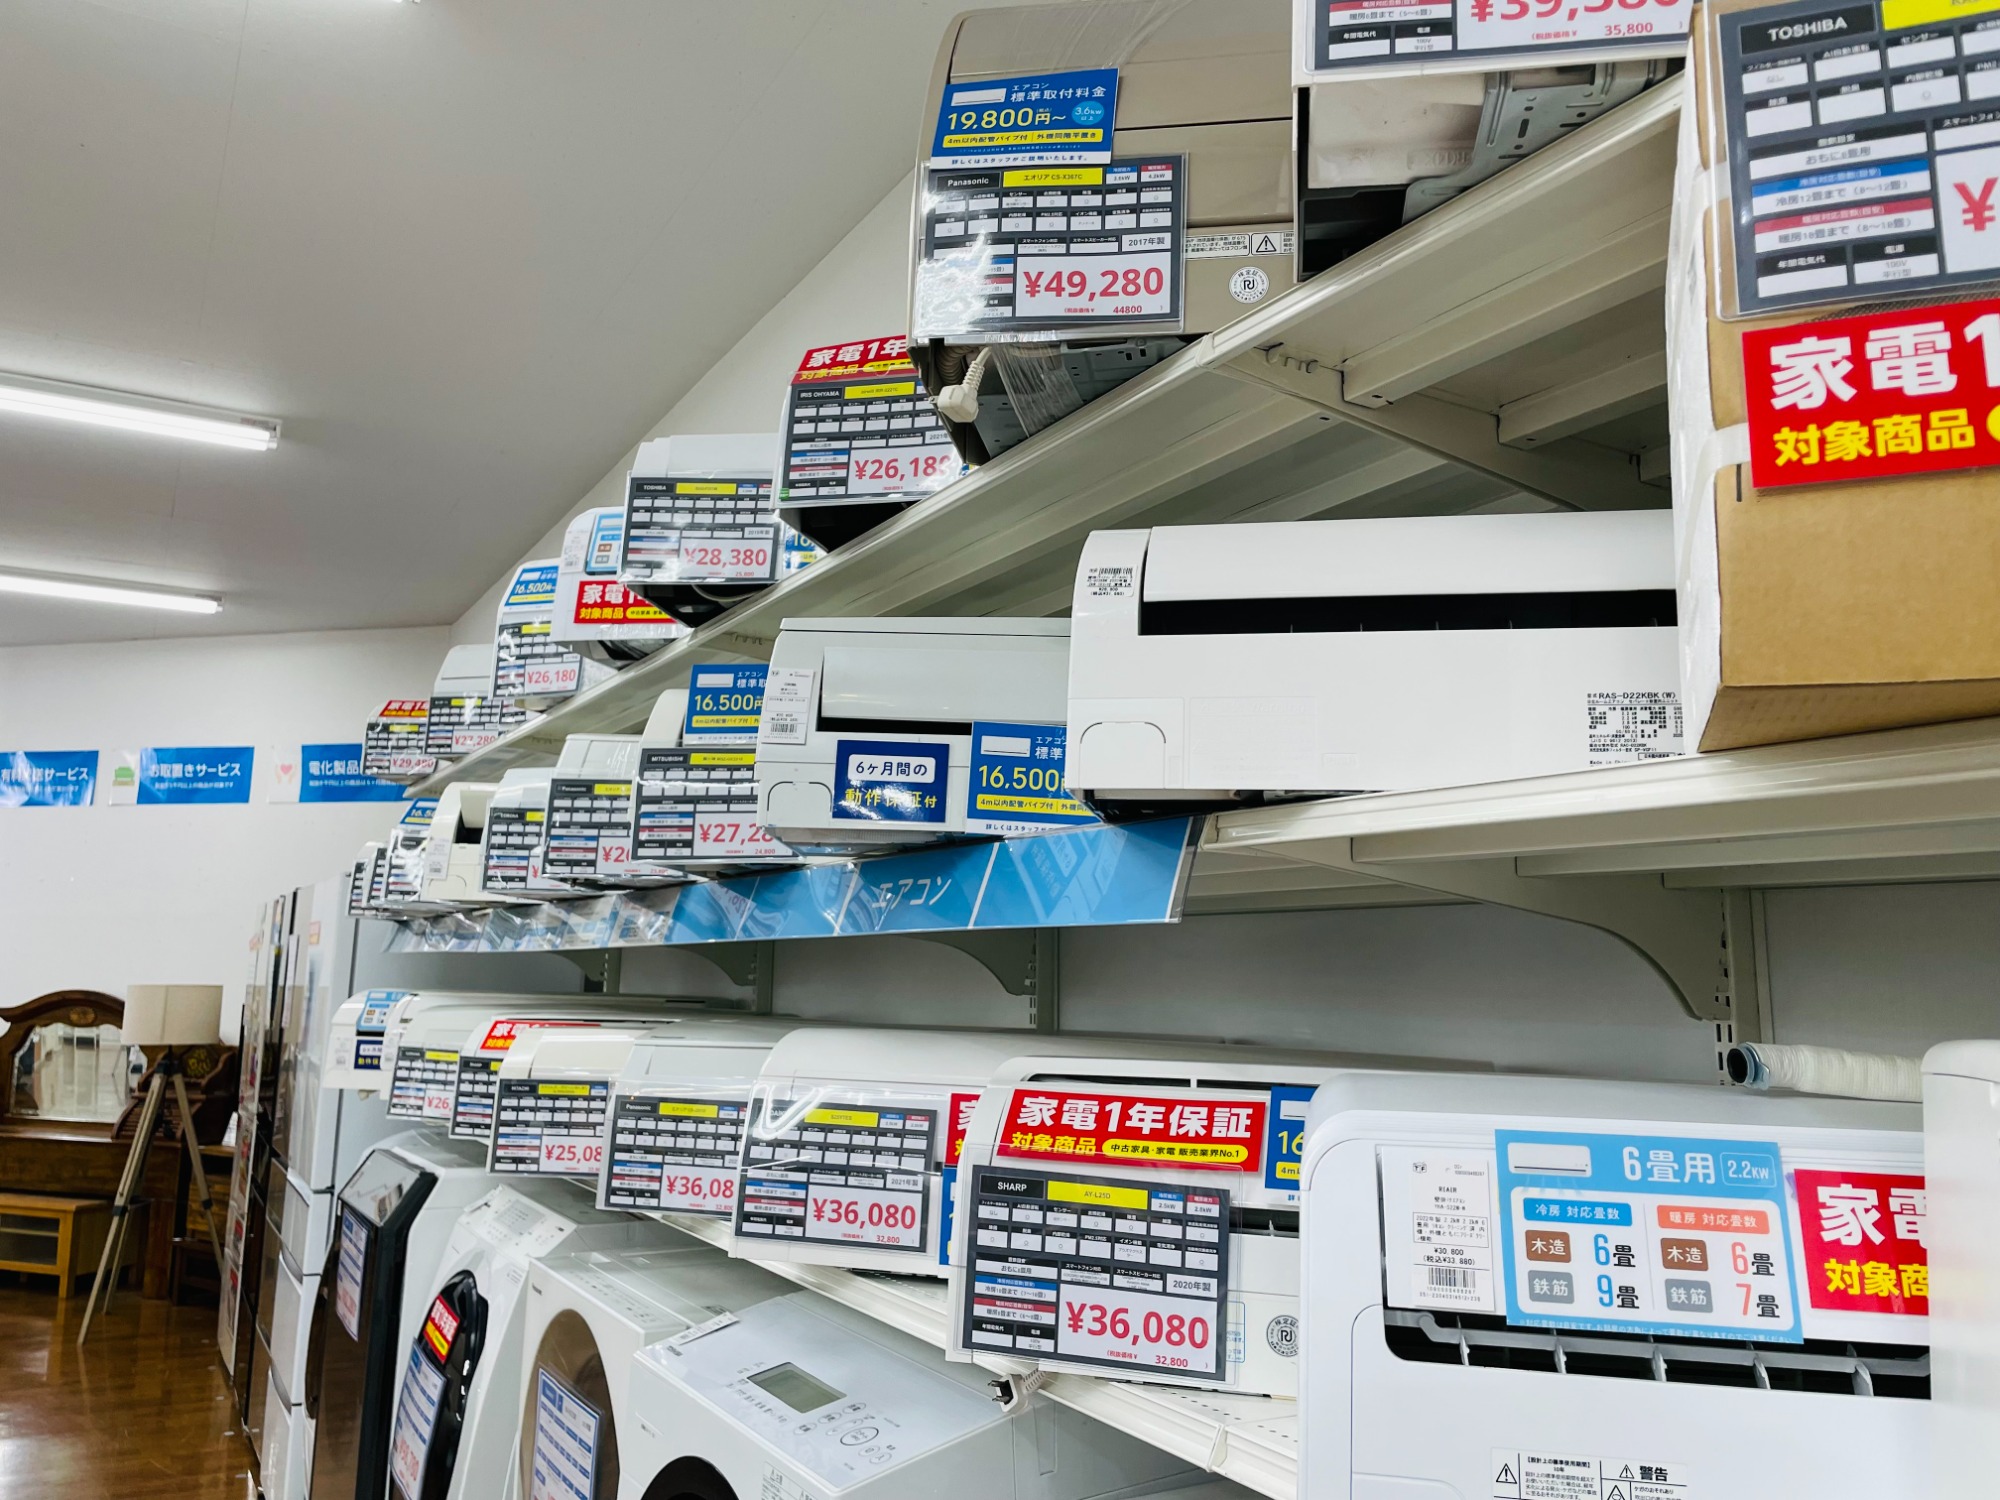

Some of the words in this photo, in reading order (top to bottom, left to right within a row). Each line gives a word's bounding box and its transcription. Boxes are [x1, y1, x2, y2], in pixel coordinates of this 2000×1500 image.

[1604, 22, 1653, 36] 35,800
[1768, 16, 1848, 41] TOSHIBA
[1010, 86, 1107, 103] 標準取付料金
[1011, 83, 1050, 91] エアコン
[948, 134, 1028, 145] 4m以内配管パイプ付
[952, 155, 1088, 165] 詳しくはスタッフがご説明いたします。
[947, 177, 989, 187] Panasonic
[1128, 237, 1165, 246] 2017年製
[1023, 267, 1164, 302] ¥49,280
[1112, 305, 1143, 314] 44800
[807, 339, 907, 368] 家電1年
[813, 390, 839, 398] OHYAMA
[1773, 408, 1976, 467] 対象商品
[684, 548, 768, 569] ¥28,380
[581, 583, 650, 605] 家電1
[579, 606, 624, 620] 対象商品
[527, 668, 577, 685] ¥26,180
[1034, 746, 1064, 760] 標準
[150, 762, 241, 779] お取置きサービス
[309, 760, 360, 776] 電化製品
[855, 761, 928, 777] 6ヶ月間の
[978, 765, 1065, 792] 16,500
[980, 798, 1054, 810] 4m以内配管パイプ付
[872, 878, 952, 909] エアコン
[626, 1103, 652, 1111] Panasonic
[1016, 1096, 1254, 1139] 家電1年保証
[1011, 1131, 1097, 1156] 対象商品
[1110, 1143, 1176, 1157] 中古家具・家電
[1178, 1147, 1240, 1159] 販売業界No.1
[1621, 1146, 1717, 1186] 6畳用
[666, 1175, 735, 1200] ¥36,08
[997, 1181, 1028, 1192] SHARP
[1084, 1190, 1111, 1199] AY-L25D
[812, 1197, 916, 1229] ¥36,080
[1535, 1204, 1561, 1217] 冷房
[1566, 1206, 1620, 1221] 対応畳数
[1669, 1211, 1699, 1225] 暖房
[1702, 1213, 1758, 1229] 対応畳数
[1817, 1183, 1927, 1250] 家電
[876, 1235, 900, 1244] 32,800
[1530, 1236, 1567, 1256] 木造
[1593, 1233, 1636, 1268] 6畳
[1666, 1245, 1703, 1263] 木造
[1730, 1241, 1776, 1277] 6畳
[1065, 1263, 1102, 1272] スマートフォン対応
[1116, 1269, 1161, 1279] スマートスピーカー対応
[1173, 1280, 1211, 1292] 2020年製
[1533, 1276, 1569, 1297] 鉄筋
[1597, 1274, 1640, 1310] 9畳
[1670, 1287, 1708, 1306] 鉄筋
[1735, 1283, 1781, 1319] 7畳
[1065, 1300, 1210, 1350] ¥36,080
[1154, 1354, 1189, 1370] 32,800
[1639, 1465, 1669, 1482] 警告
[1633, 1485, 1674, 1495] ケガのおそれあり
